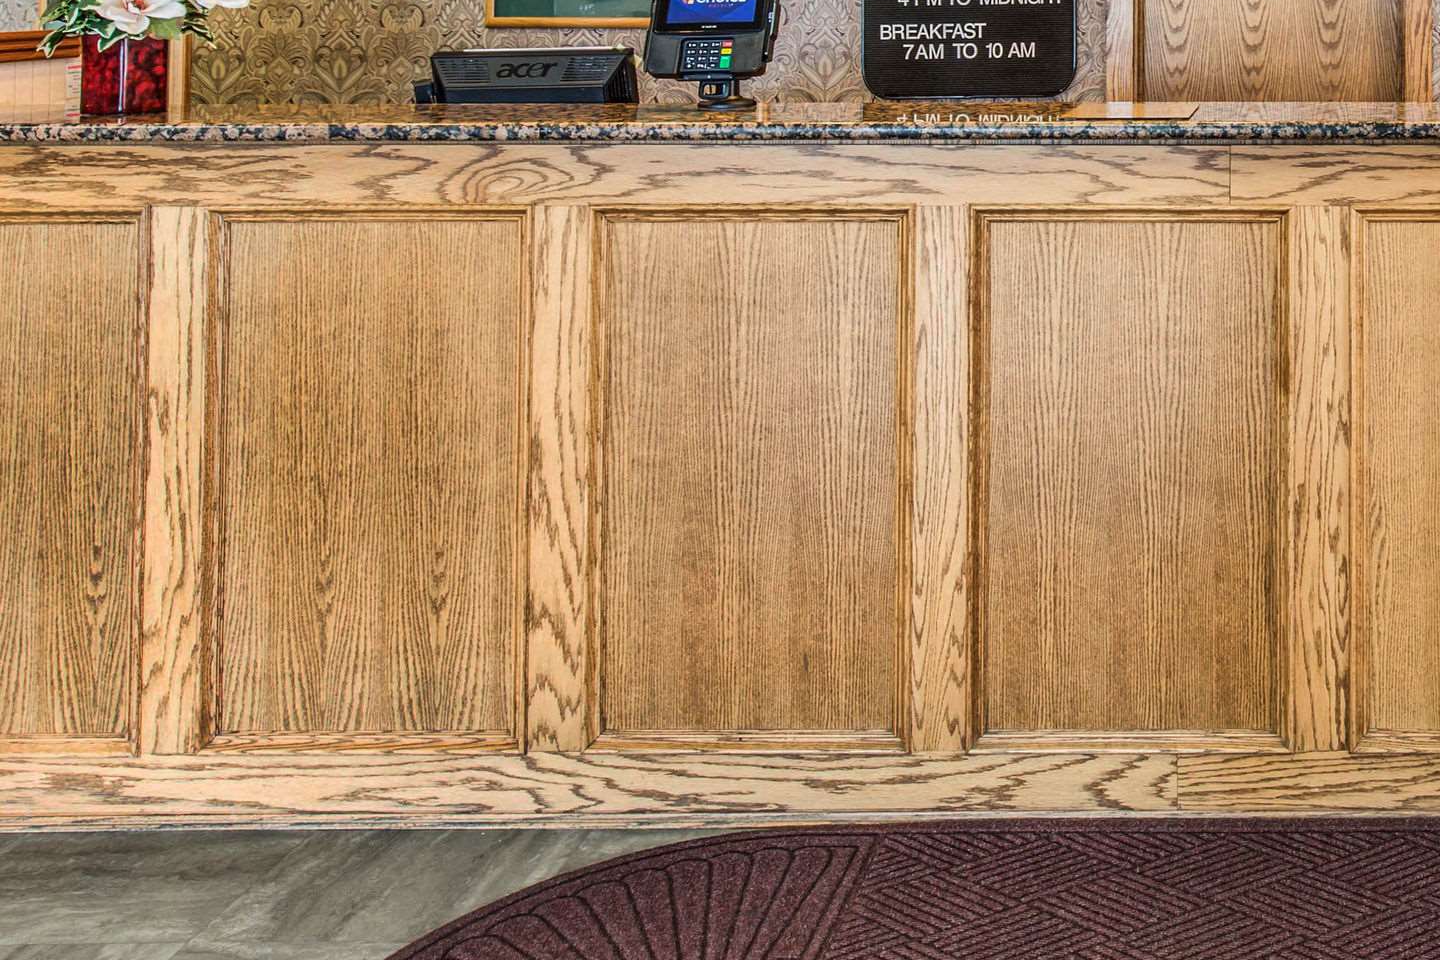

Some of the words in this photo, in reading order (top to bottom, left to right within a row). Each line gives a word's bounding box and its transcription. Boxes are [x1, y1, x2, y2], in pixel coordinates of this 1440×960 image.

[880, 23, 986, 40] BREAKFAST
[953, 43, 978, 59] TO
[986, 43, 1003, 59] 10
[1008, 42, 1035, 59] AM
[496, 62, 558, 78] acer
